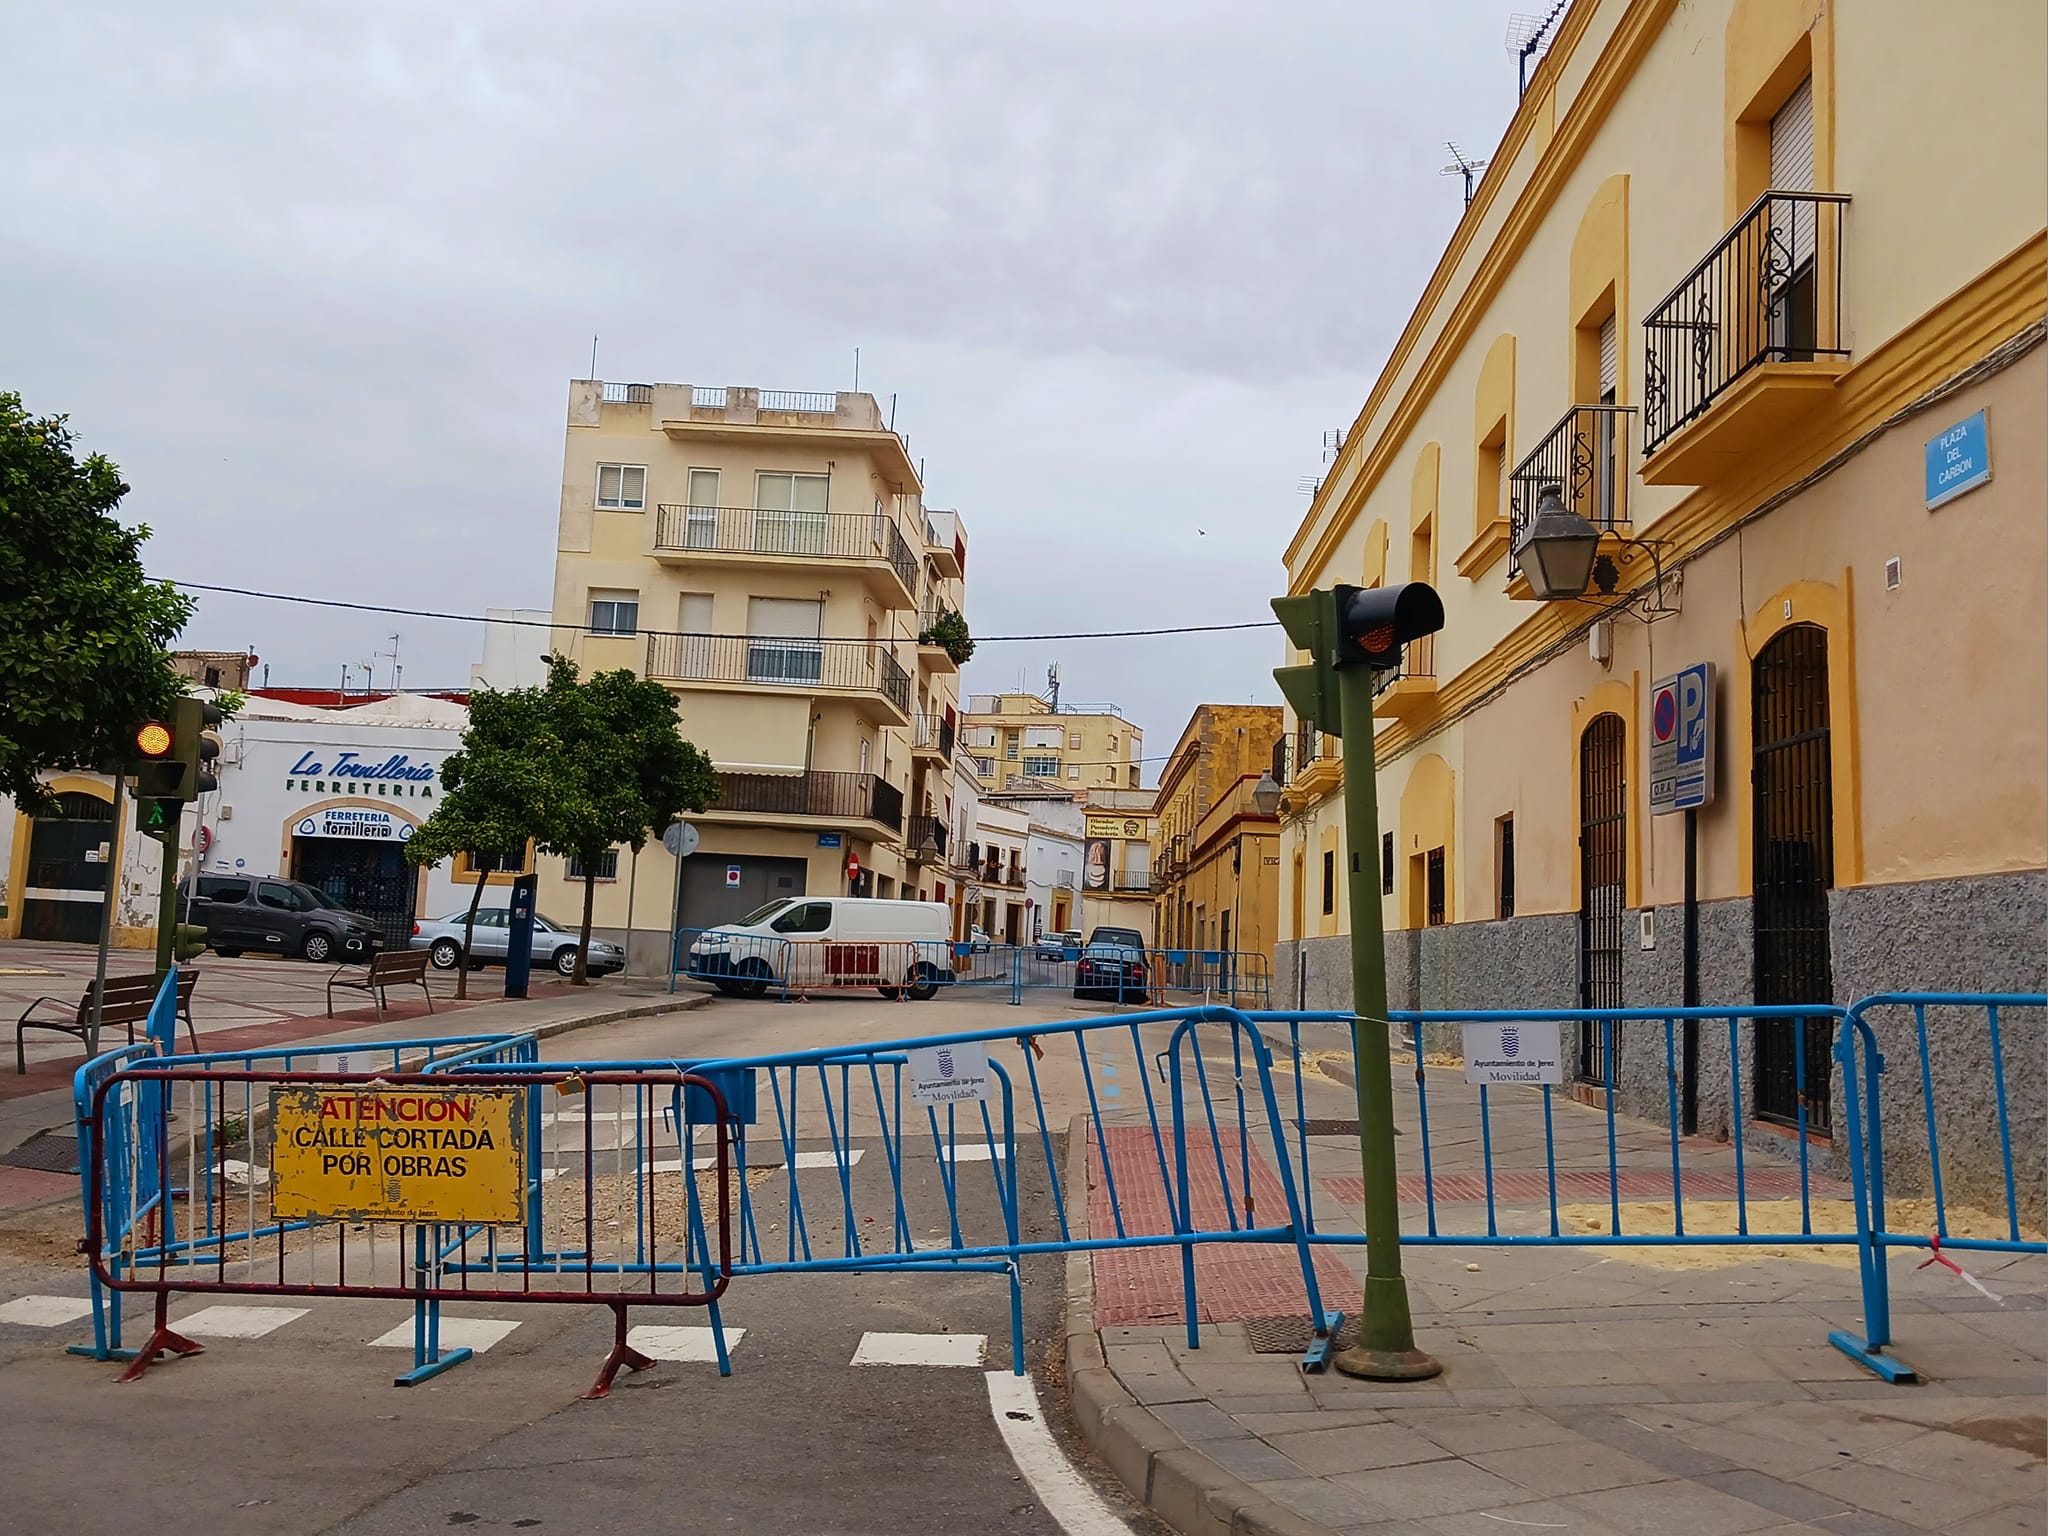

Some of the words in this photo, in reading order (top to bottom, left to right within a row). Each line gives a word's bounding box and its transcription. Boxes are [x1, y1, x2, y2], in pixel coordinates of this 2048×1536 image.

[1940, 425, 1967, 451] PLAZA
[1946, 447, 1962, 464] DEL
[1938, 456, 1973, 485] CARBON
[1679, 671, 1704, 748] P
[289, 750, 323, 776] La
[328, 752, 435, 781] Tornillería
[286, 779, 433, 798] FERRETERIA
[325, 811, 390, 823] FERRETERIA
[325, 820, 389, 838] Tornillería
[519, 888, 528, 900] P
[1474, 1060, 1525, 1069] Ayuntamiento
[1489, 1071, 1541, 1081] Movilidad
[319, 1096, 470, 1122] ATENCION
[295, 1126, 366, 1148] CALLE
[380, 1128, 495, 1150] CORTADA
[322, 1154, 372, 1176] POR
[383, 1155, 467, 1178] OBRAS
